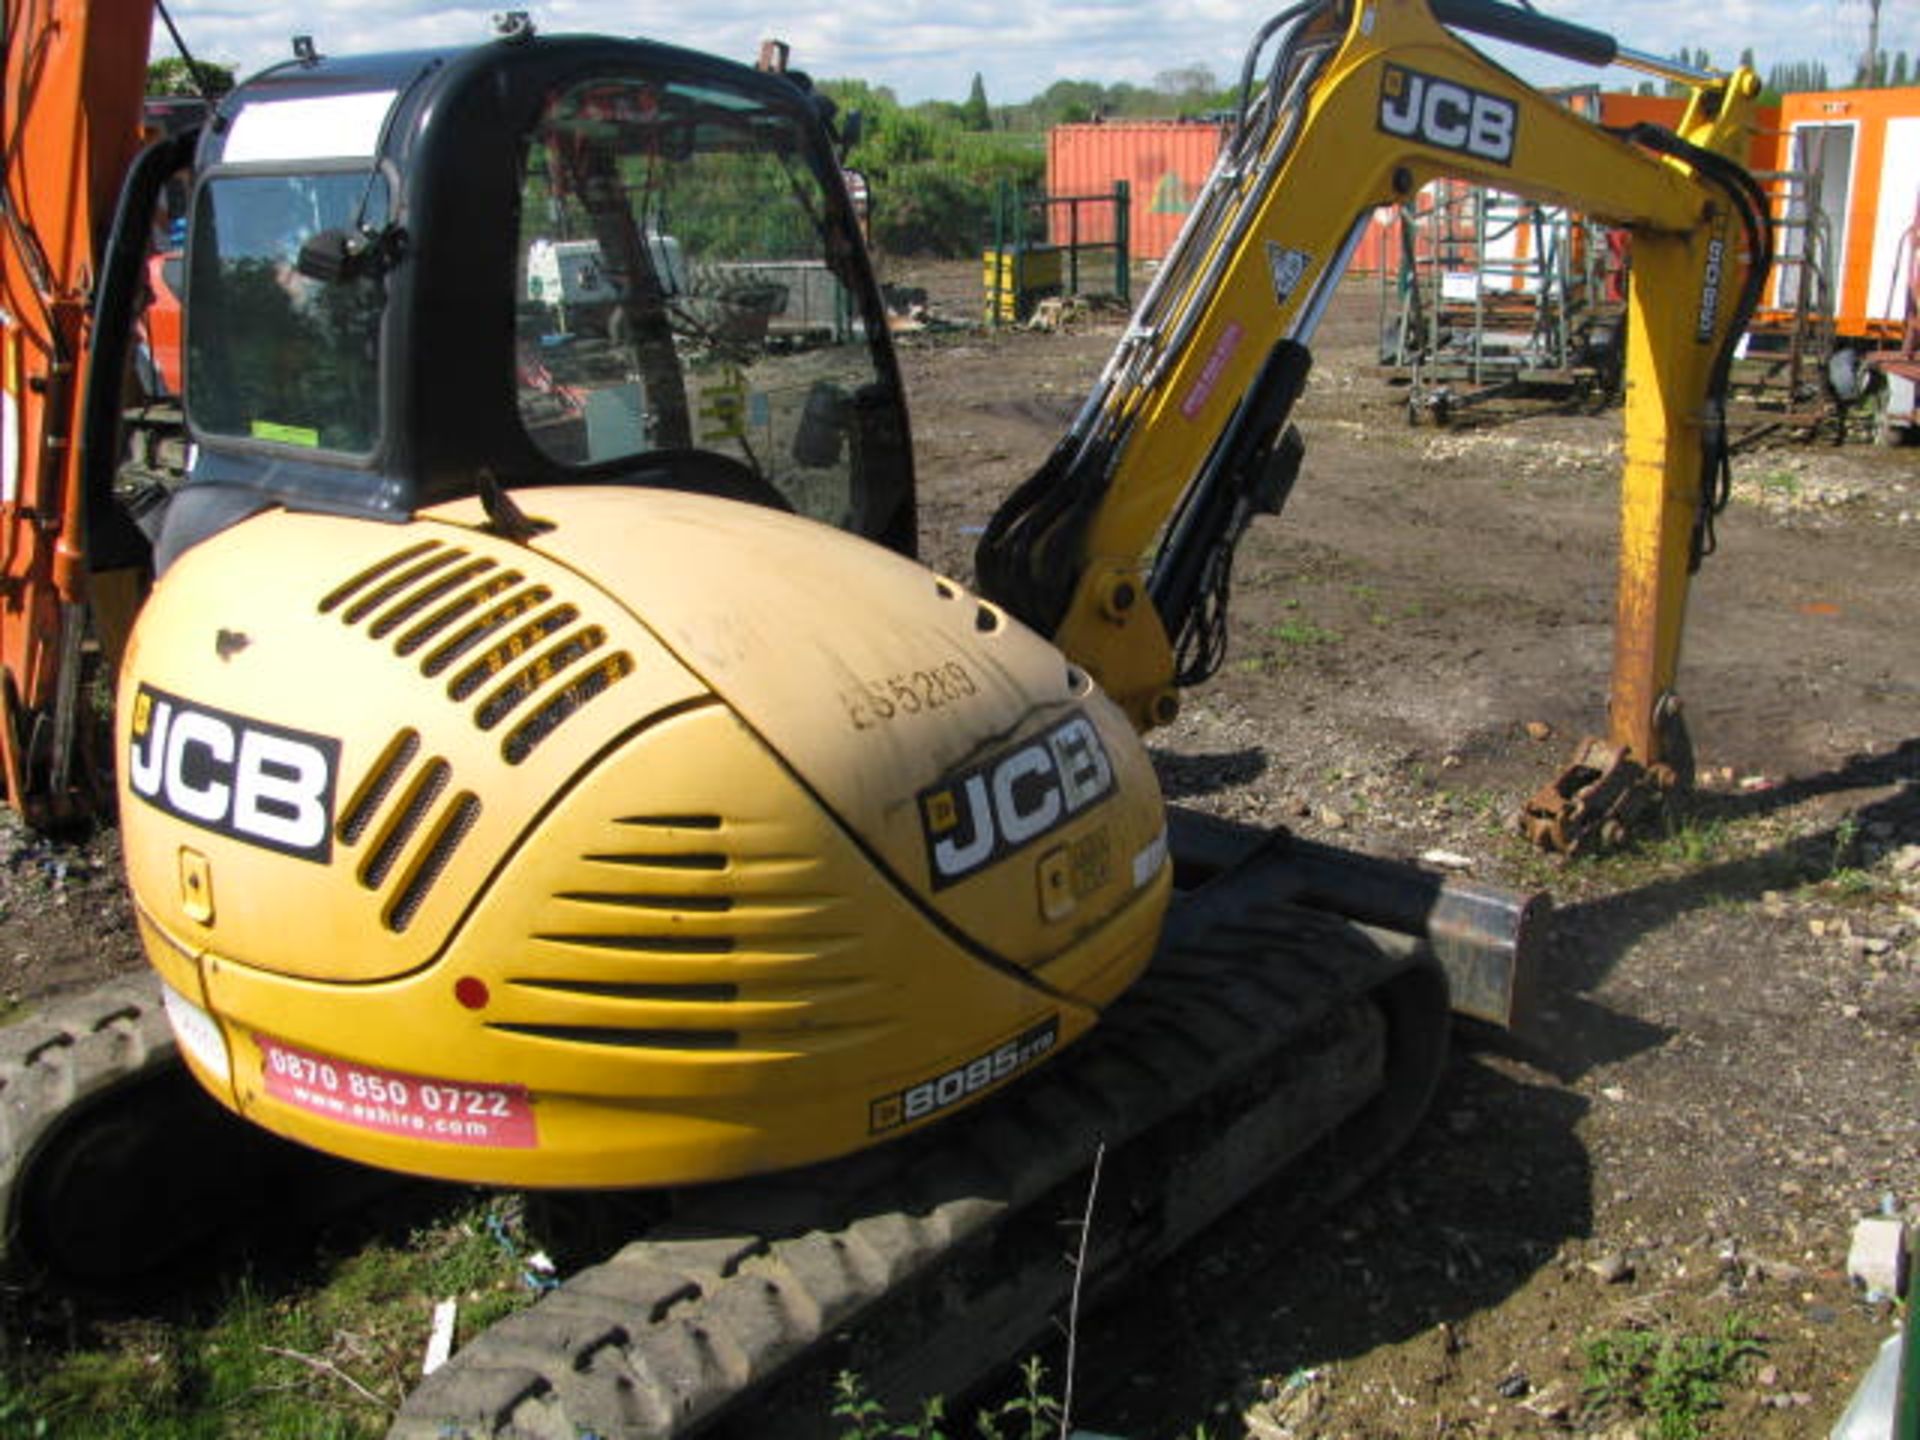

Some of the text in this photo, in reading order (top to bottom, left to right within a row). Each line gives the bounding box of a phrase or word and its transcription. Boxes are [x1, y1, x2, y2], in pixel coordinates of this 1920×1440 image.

[1381, 75, 1514, 162] JCB
[129, 699, 329, 850] JCB
[935, 718, 1112, 877] JCB
[269, 1046, 512, 1119] 0870 850 0722
